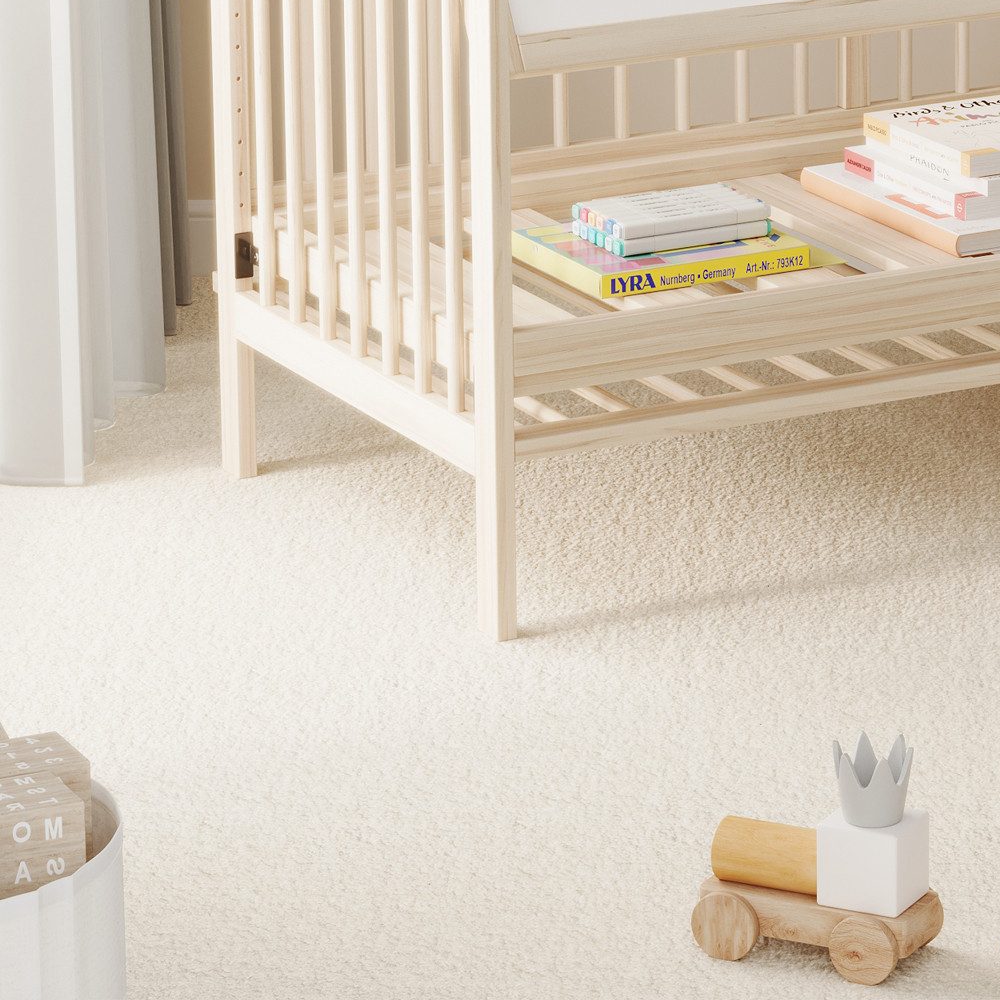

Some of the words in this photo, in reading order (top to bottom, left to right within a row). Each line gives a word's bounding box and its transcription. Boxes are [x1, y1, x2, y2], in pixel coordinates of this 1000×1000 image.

[893, 107, 941, 120] Birds
[908, 154, 951, 177] PHAIDON
[610, 273, 656, 295] LYRA
[660, 273, 696, 287] Nurnberg
[702, 266, 736, 281] Germany
[776, 255, 804, 270] 793K12
